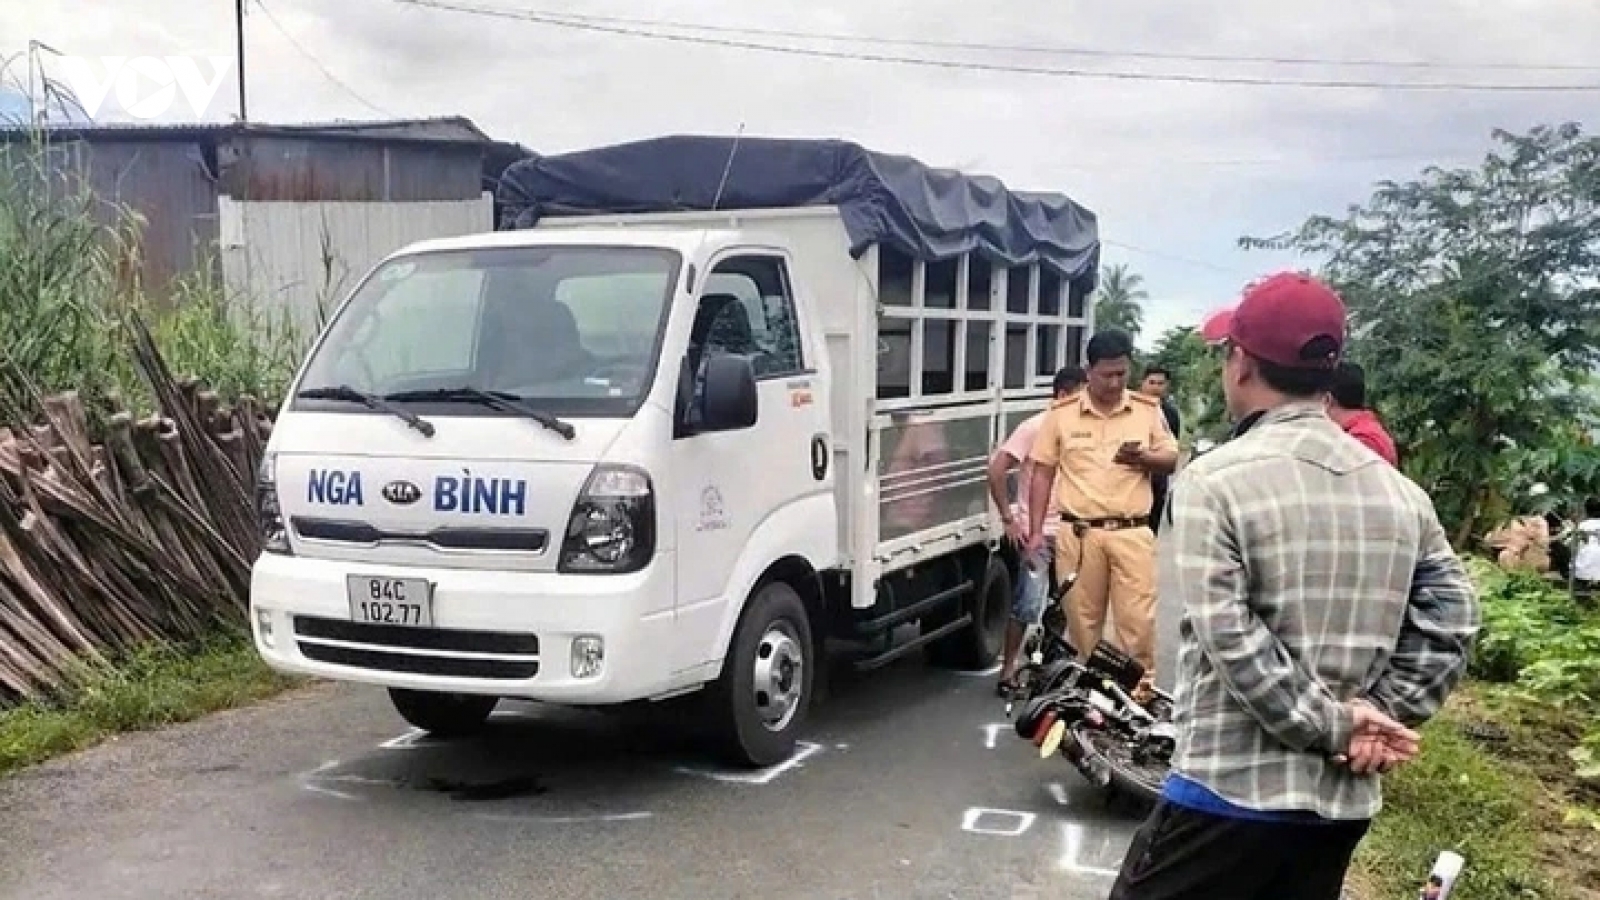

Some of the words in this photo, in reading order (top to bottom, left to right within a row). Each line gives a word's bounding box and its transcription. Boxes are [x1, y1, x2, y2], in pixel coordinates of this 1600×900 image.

[308, 469, 364, 506] NGA
[434, 468, 527, 515] BÌNH
[384, 483, 420, 502] KIA
[370, 579, 405, 600] 84C
[361, 601, 421, 624] 102.77
